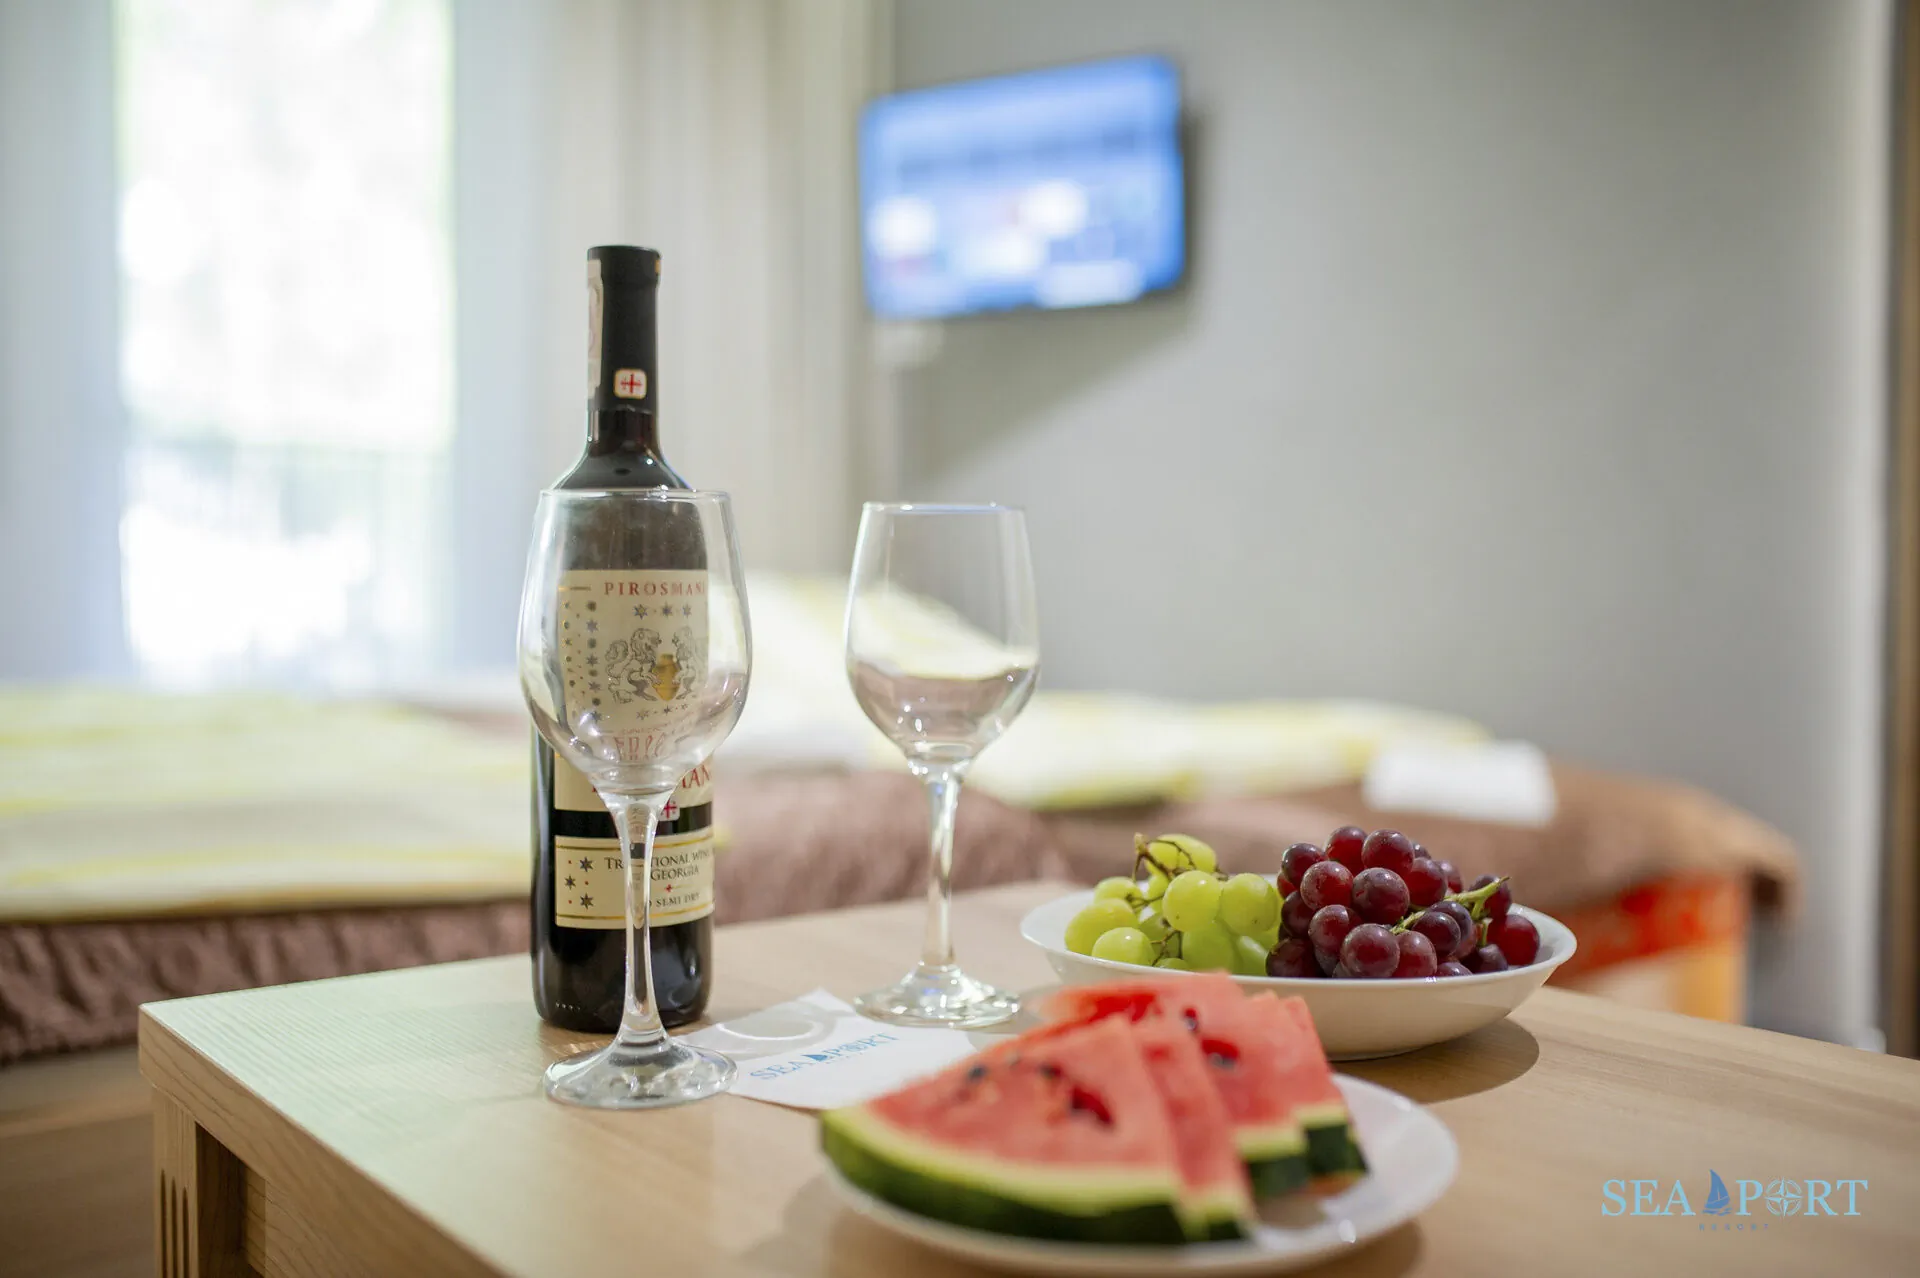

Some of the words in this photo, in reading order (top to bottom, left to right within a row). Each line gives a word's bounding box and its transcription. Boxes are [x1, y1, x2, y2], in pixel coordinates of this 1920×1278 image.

[603, 853, 690, 870] TRTIONAL
[691, 849, 710, 861] WIN
[650, 864, 700, 881] GEORGIA
[750, 1060, 814, 1080] SEA
